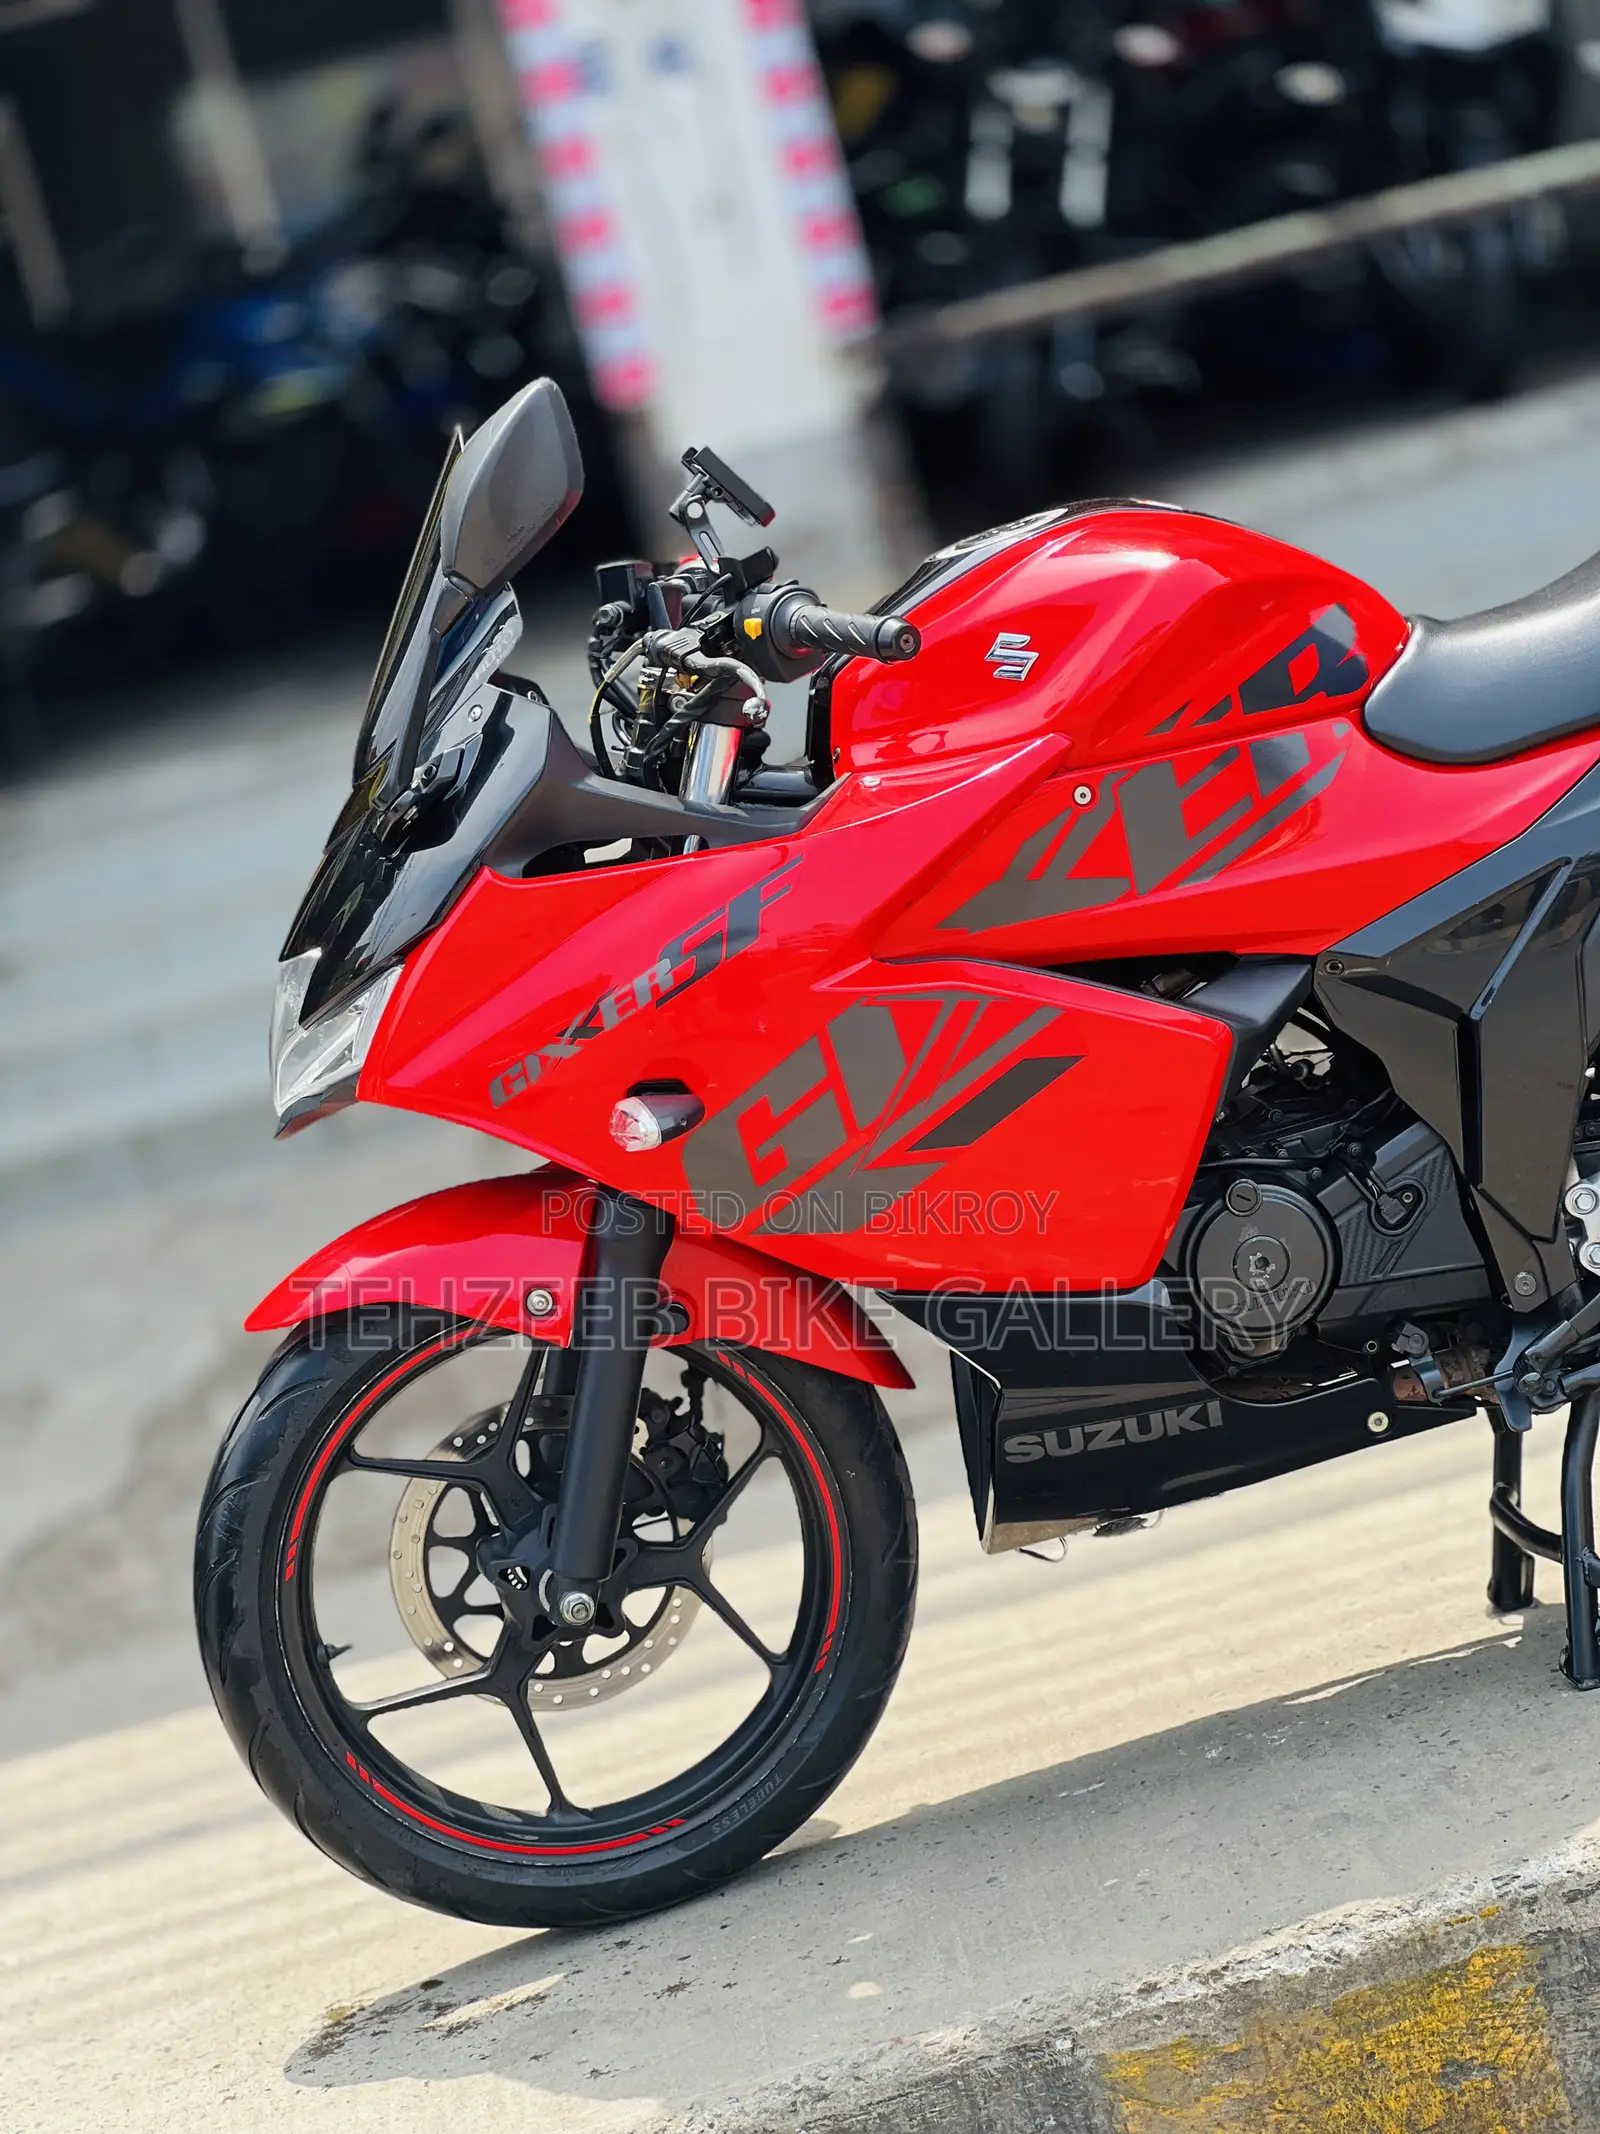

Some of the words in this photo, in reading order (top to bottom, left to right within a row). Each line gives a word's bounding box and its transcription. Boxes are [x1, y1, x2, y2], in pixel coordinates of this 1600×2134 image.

[489, 957, 674, 1109] GIXXER
[1003, 1399, 1224, 1464] SUZUKI
[712, 1773, 783, 1834] TUBELESS
